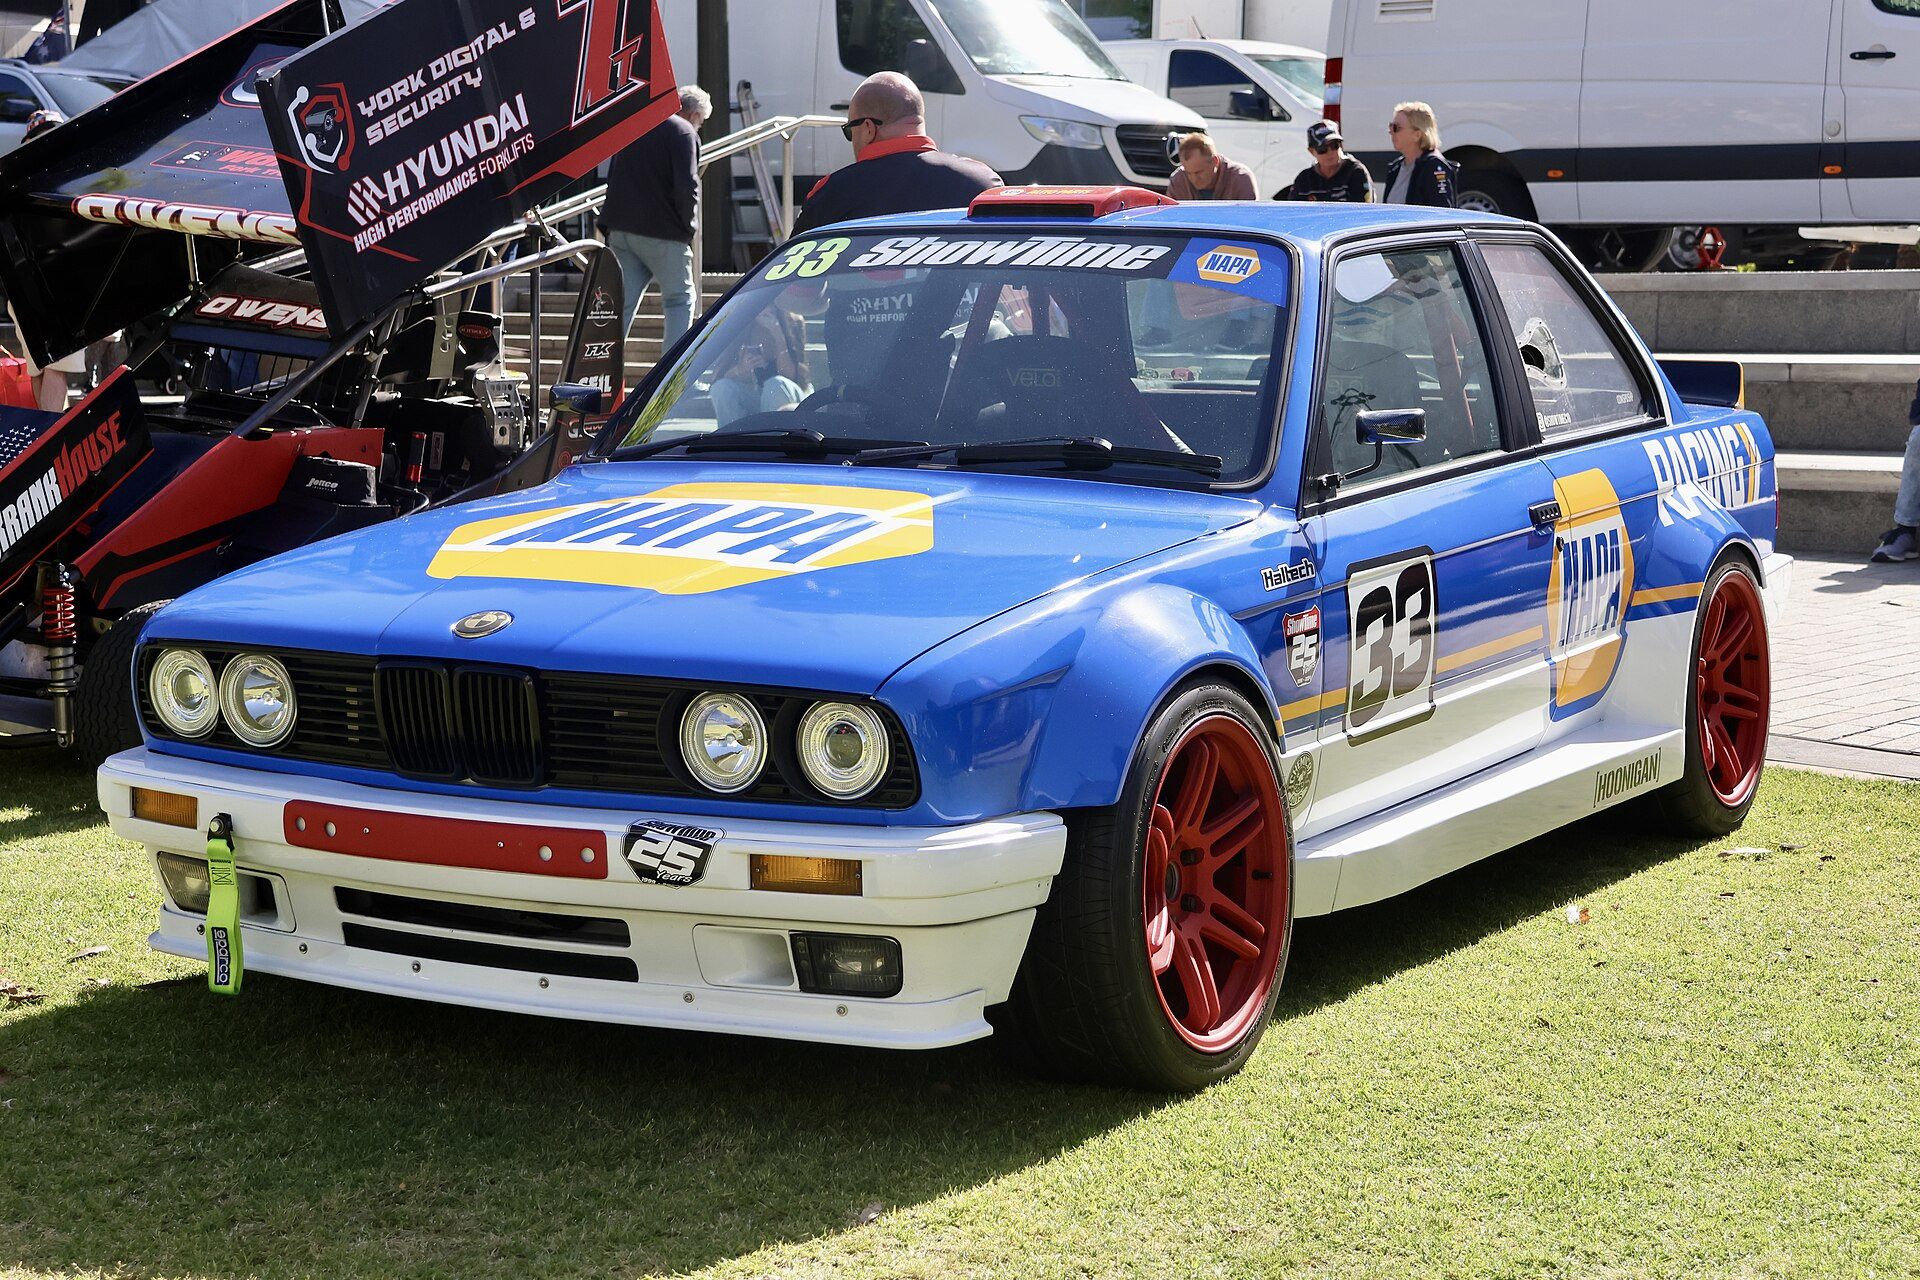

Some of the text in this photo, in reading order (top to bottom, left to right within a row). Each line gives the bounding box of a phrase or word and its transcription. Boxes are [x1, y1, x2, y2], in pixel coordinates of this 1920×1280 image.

[357, 6, 537, 118] YORK DIGITAL &
[365, 67, 483, 146] SECURITY
[382, 92, 531, 206] HYUNDAI
[353, 132, 536, 254] HIGH PERFORMANCE FORKLIFTS
[75, 195, 302, 246] OWENS
[765, 237, 852, 281] 33
[1205, 253, 1256, 277] NAPA
[199, 297, 328, 330] OWENS
[1642, 424, 1746, 527] RACING
[485, 502, 884, 565] NAPA
[1262, 558, 1315, 590] Haltech
[1559, 528, 1621, 647] NAPA
[1290, 633, 1318, 670] 25
[1350, 561, 1432, 728] 33
[627, 830, 704, 877] 25
[656, 869, 693, 883] Years
[214, 929, 228, 983] sparco
